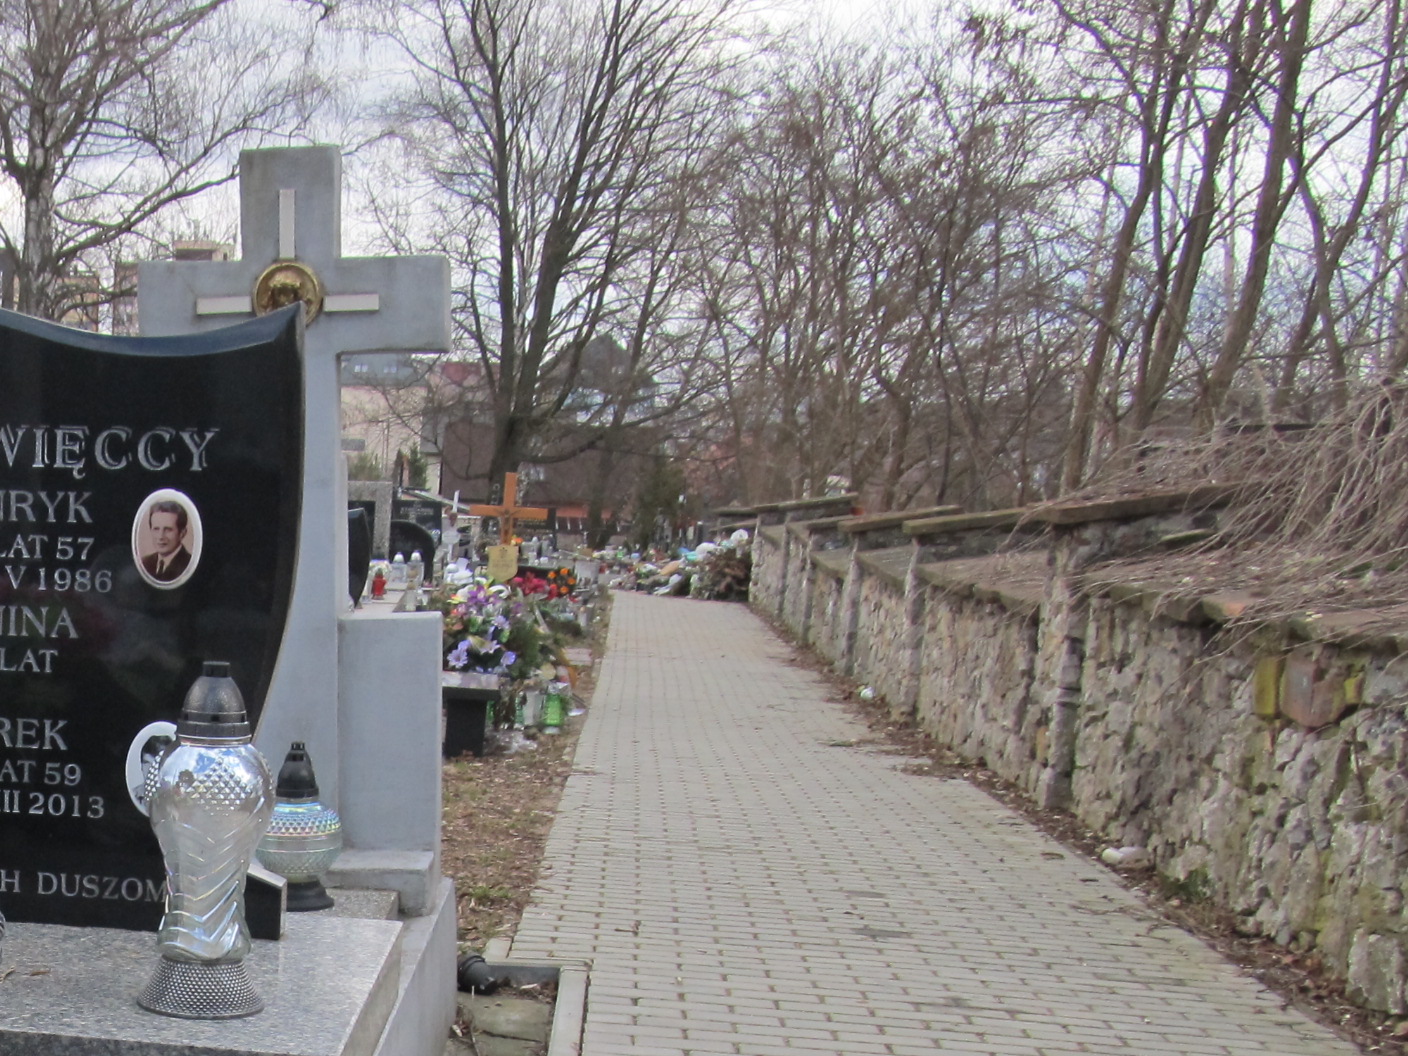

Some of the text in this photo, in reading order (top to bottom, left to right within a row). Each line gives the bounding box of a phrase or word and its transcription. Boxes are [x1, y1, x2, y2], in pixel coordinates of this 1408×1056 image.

[56, 537, 95, 560] 57
[5, 565, 27, 590] V
[38, 568, 112, 593] 1986
[0, 648, 58, 673] LAT
[44, 763, 82, 786] 59
[29, 792, 105, 819] 2013
[38, 871, 169, 903] DUSZOM
